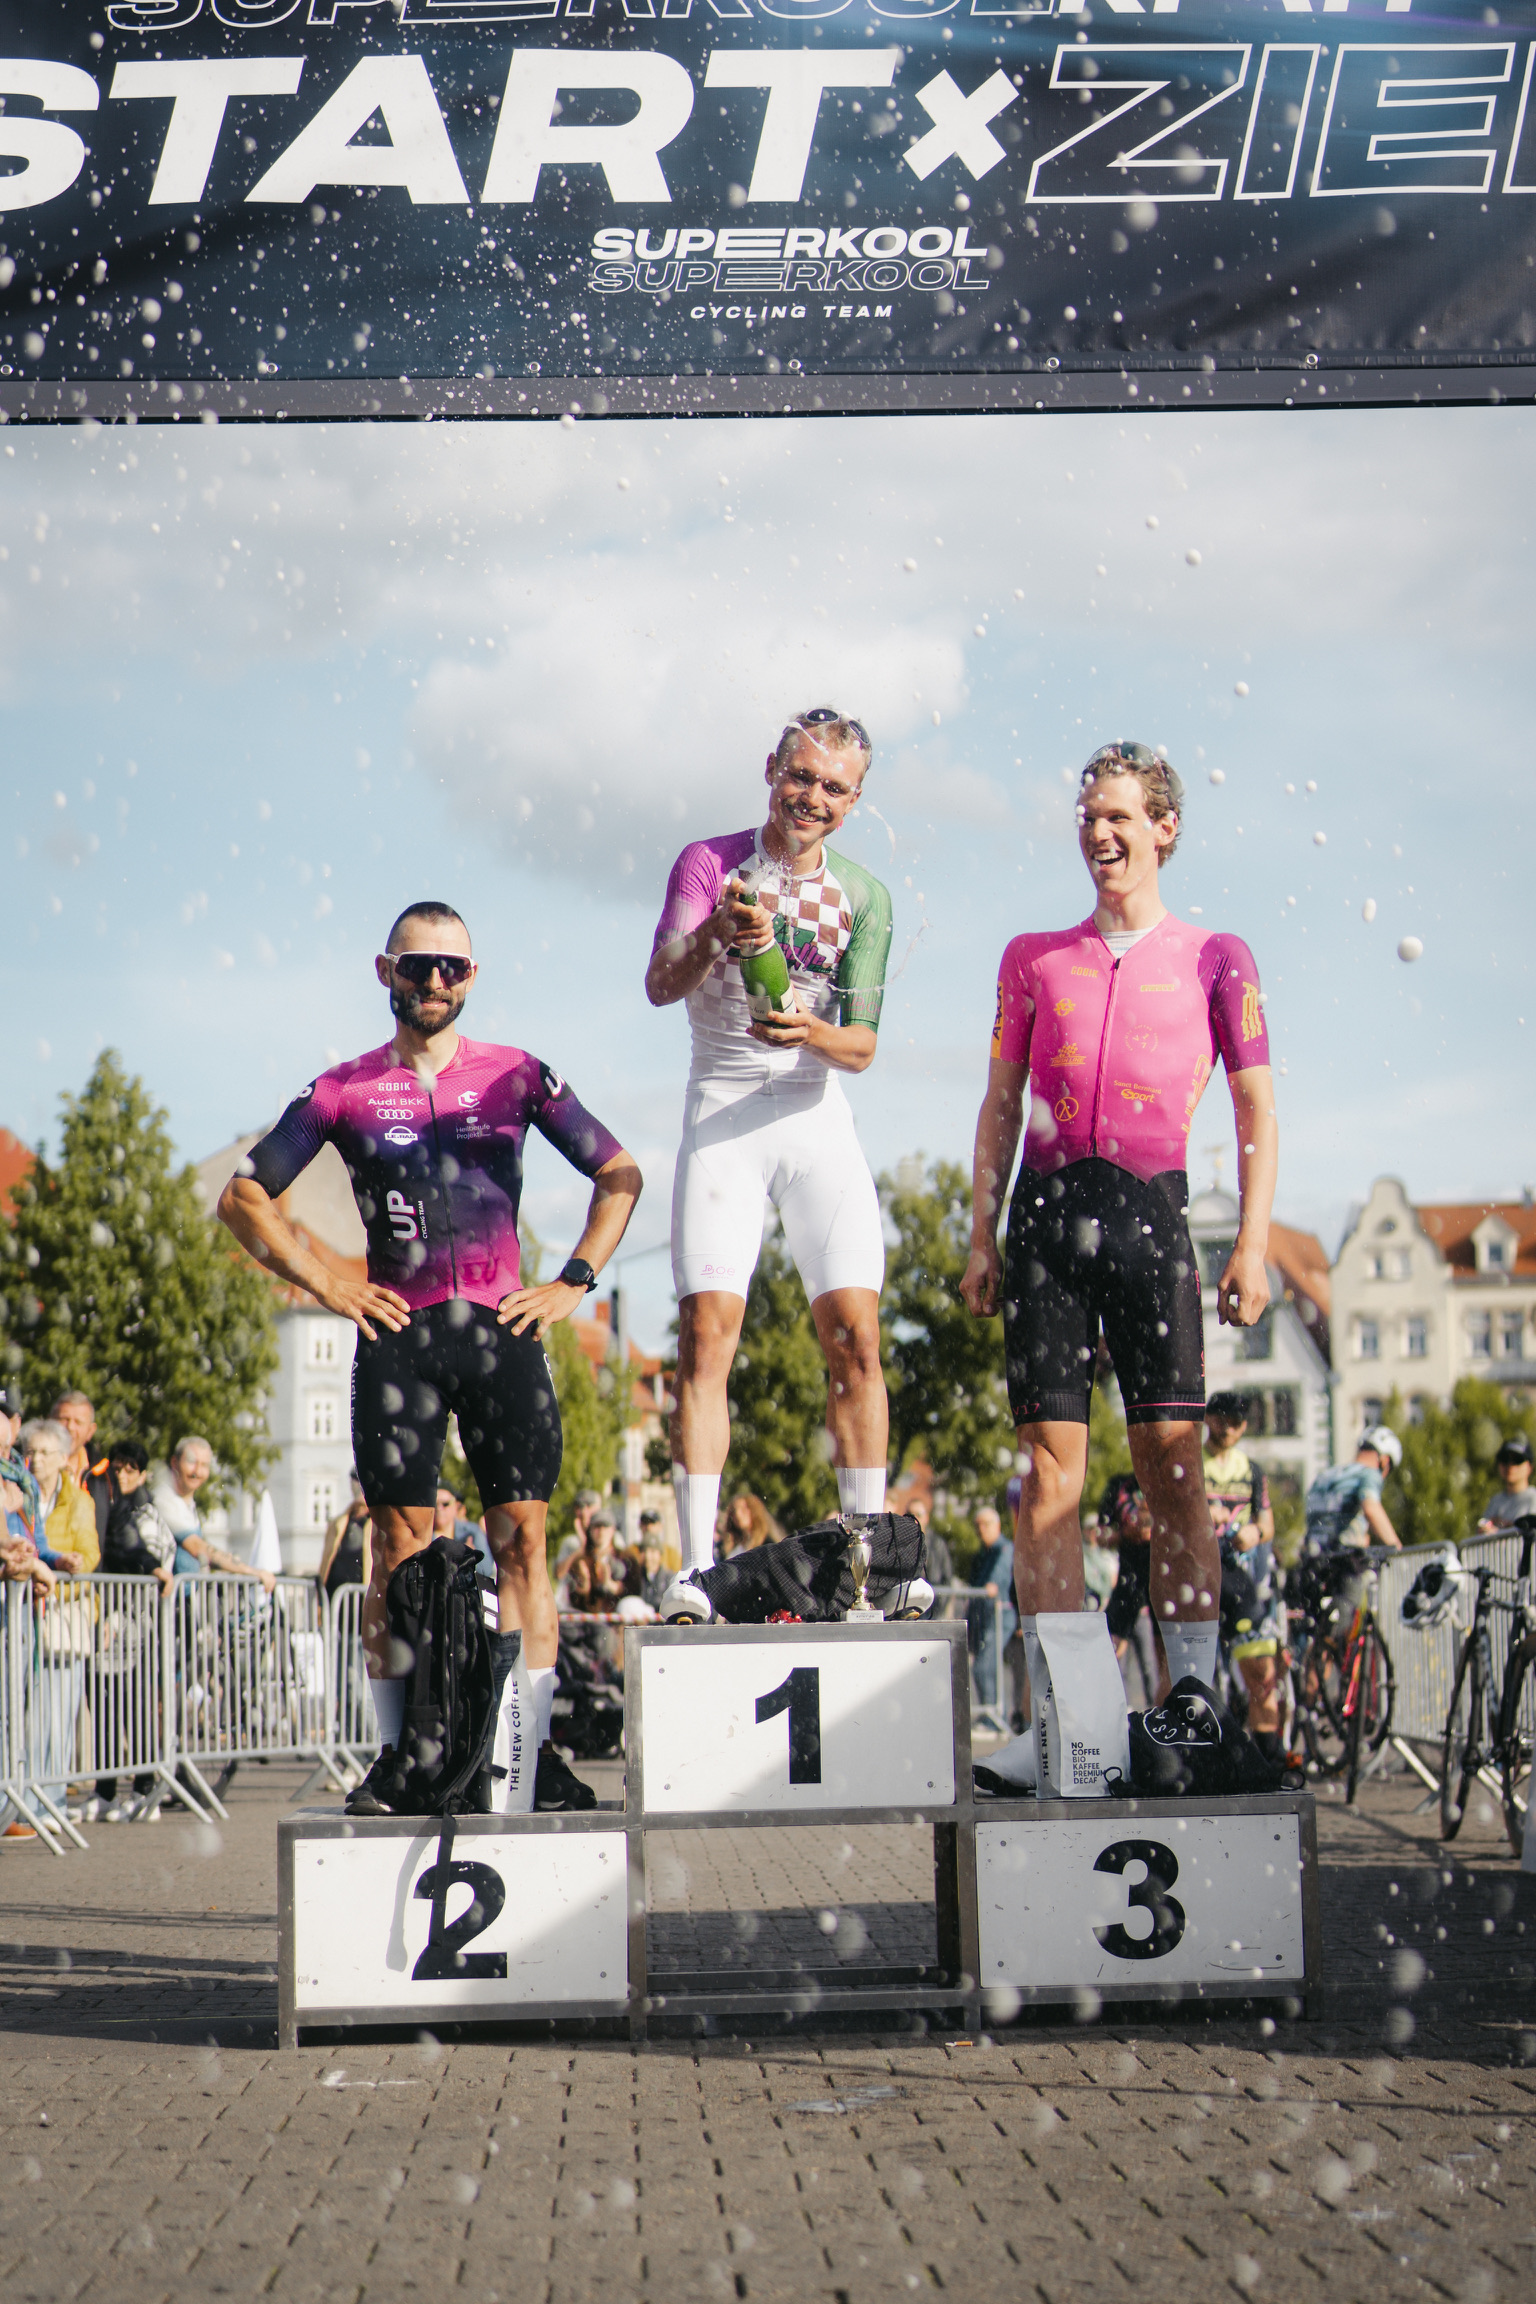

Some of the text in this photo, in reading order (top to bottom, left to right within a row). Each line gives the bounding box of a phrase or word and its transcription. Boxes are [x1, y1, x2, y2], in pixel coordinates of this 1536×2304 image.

[1025, 42, 1536, 204] ZIE
[591, 227, 988, 259] SUPERKOOL
[592, 259, 990, 293] SUPERKOOL
[690, 305, 892, 319] CYCLING TEAM
[1071, 966, 1099, 978] GOBIK
[378, 1082, 411, 1091] GOBIK
[1121, 1088, 1155, 1103] Sport
[367, 1098, 425, 1106] Audi BKK
[386, 1190, 417, 1239] UP
[420, 1216, 428, 1239] CYCLING
[755, 1667, 822, 1784] 1
[1040, 1717, 1048, 1747] NEW
[512, 1732, 522, 1762] NEW
[1071, 1741, 1084, 1749] NO
[1072, 1748, 1101, 1756] COFFEE
[1042, 1752, 1050, 1778] THE
[1073, 1762, 1100, 1770] KAFFEE
[1073, 1769, 1106, 1777] PREMIUM
[509, 1767, 520, 1792] THE
[1073, 1777, 1098, 1785] DECAF
[1092, 1839, 1186, 1960] 3
[411, 1860, 508, 1980] 2
